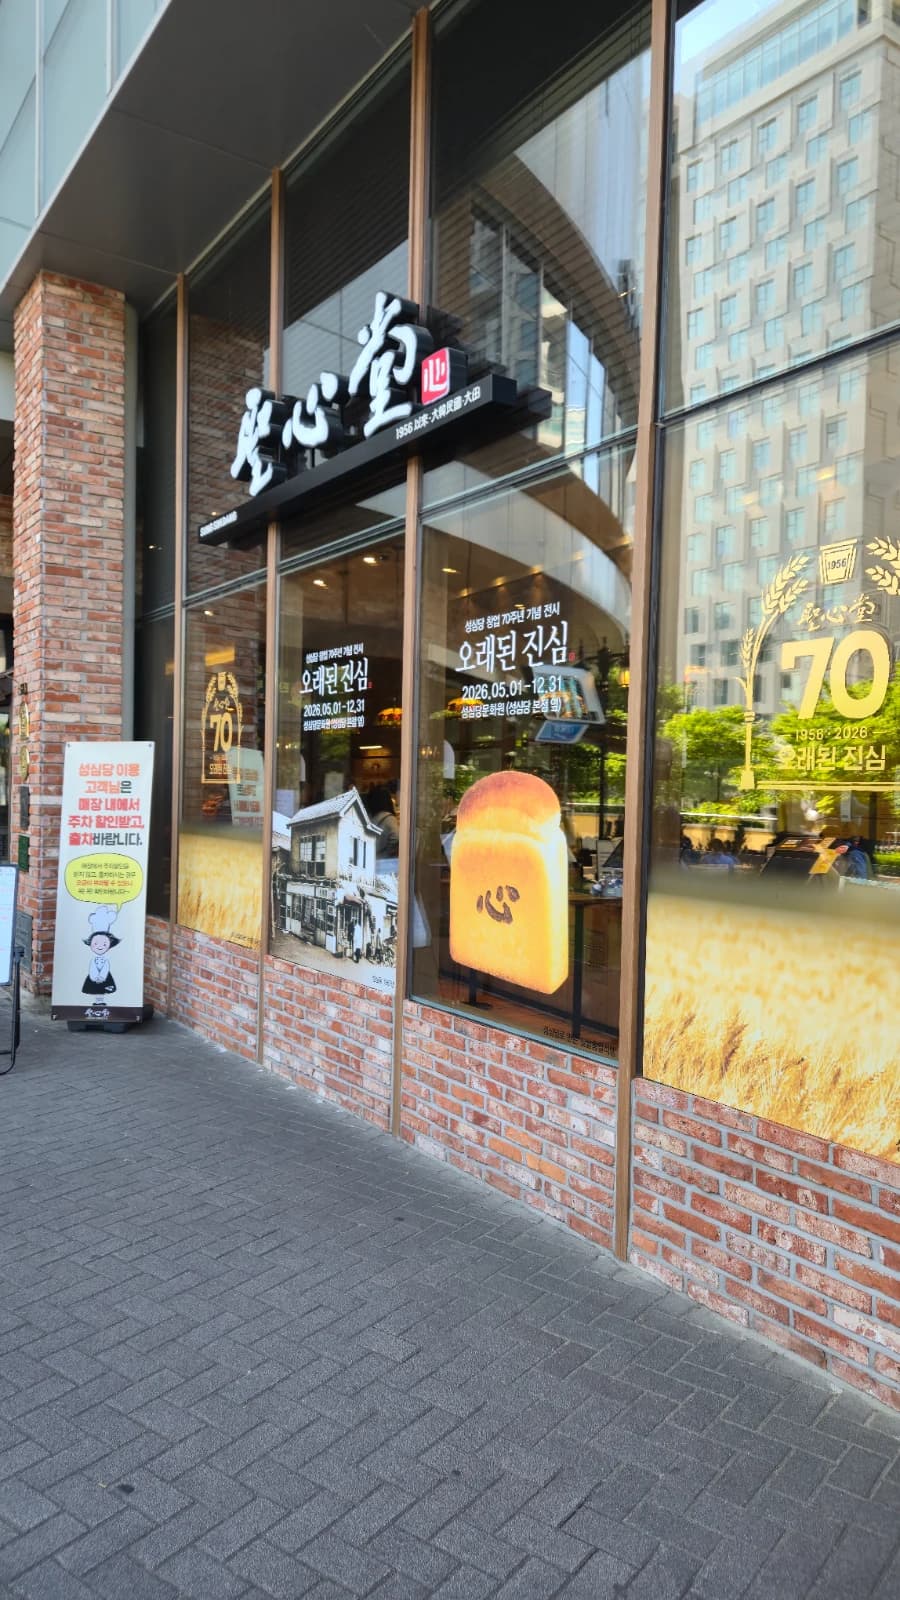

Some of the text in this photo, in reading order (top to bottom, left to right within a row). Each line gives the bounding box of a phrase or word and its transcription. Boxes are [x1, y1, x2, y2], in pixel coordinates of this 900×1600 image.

[395, 421, 413, 440] 1956
[827, 557, 847, 570] 1956
[464, 601, 560, 633] 성심당 창업 70주년 기념 전시
[455, 620, 568, 673] 오래된 진심
[299, 657, 369, 696] 오래된 진심
[780, 630, 890, 720] 70
[462, 675, 561, 700] 2026.05.01-12.31
[303, 698, 365, 717] 2026.05.01-12.31
[461, 702, 505, 719] 성심당문화원
[505, 700, 531, 716] (성심당
[209, 712, 233, 752] 70
[778, 744, 886, 771] 오래된 진심
[79, 763, 140, 777] 성심당 이용
[85, 780, 132, 794] 고객님은
[79, 797, 140, 811] 매장 내에서
[68, 815, 93, 828] 주차
[69, 832, 143, 846] 출차바랍니다.
